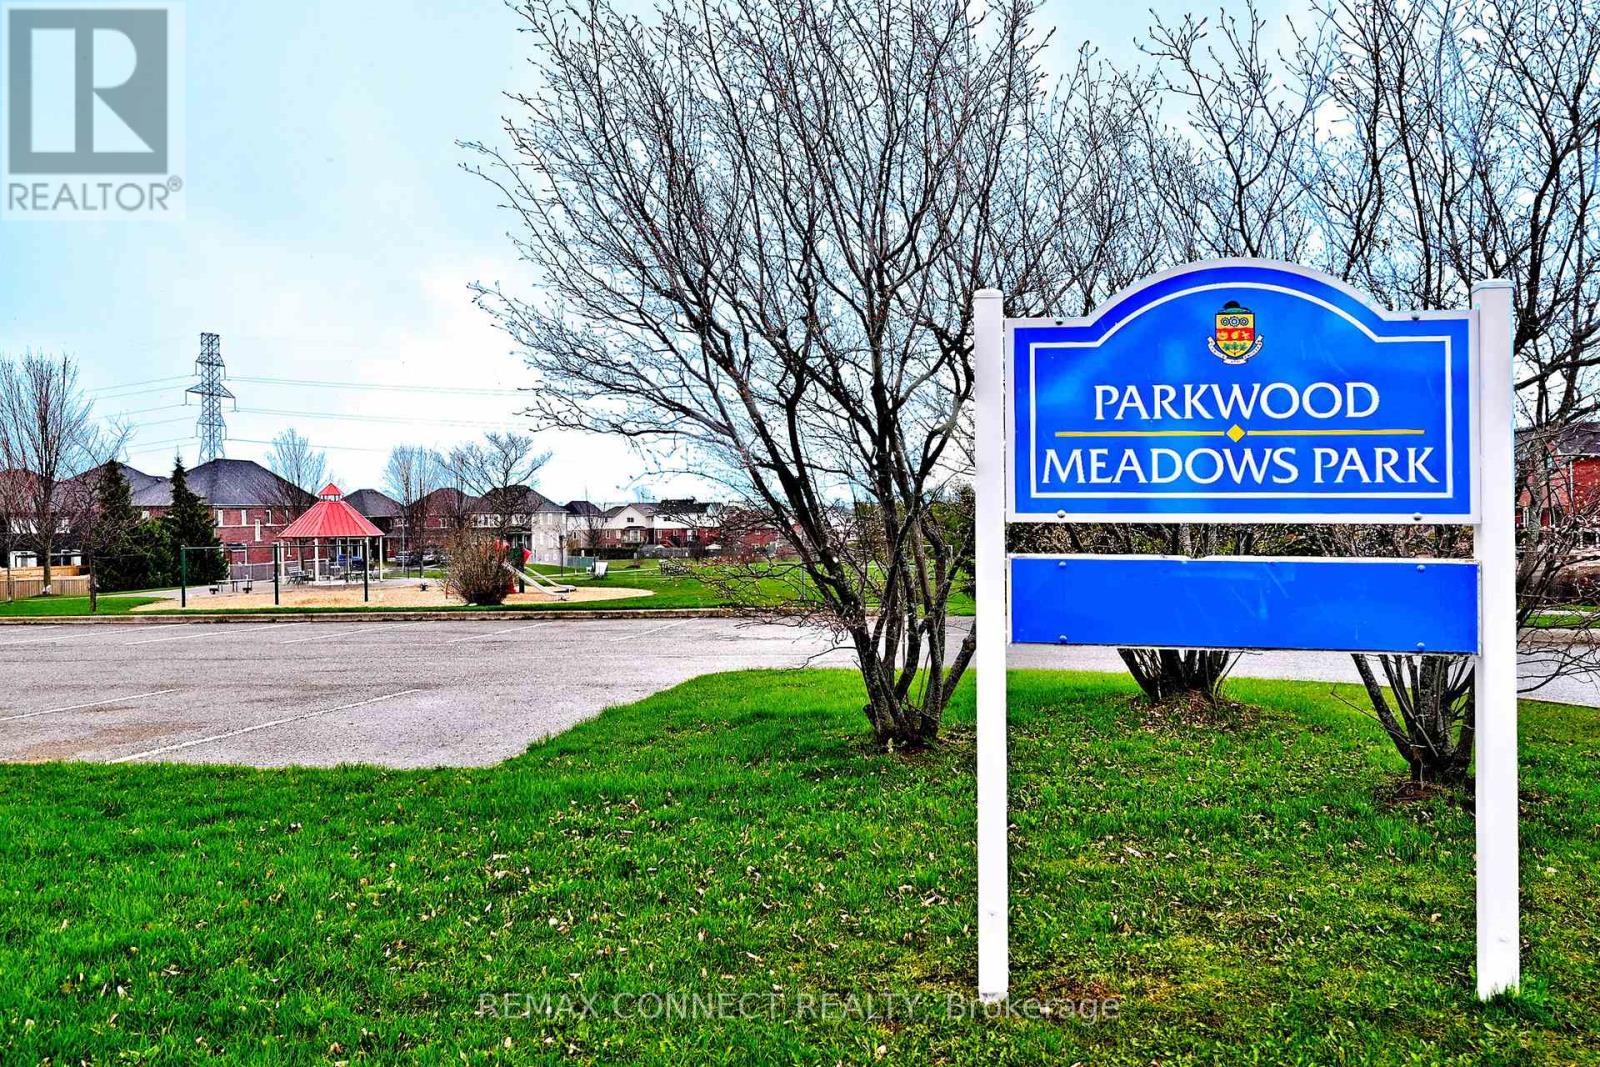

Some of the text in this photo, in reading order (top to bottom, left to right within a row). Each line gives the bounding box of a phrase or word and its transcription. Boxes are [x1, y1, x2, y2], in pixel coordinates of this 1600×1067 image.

[1094, 382, 1380, 420] PARKWOOD
[1042, 446, 1439, 484] MEADOWS PARK
